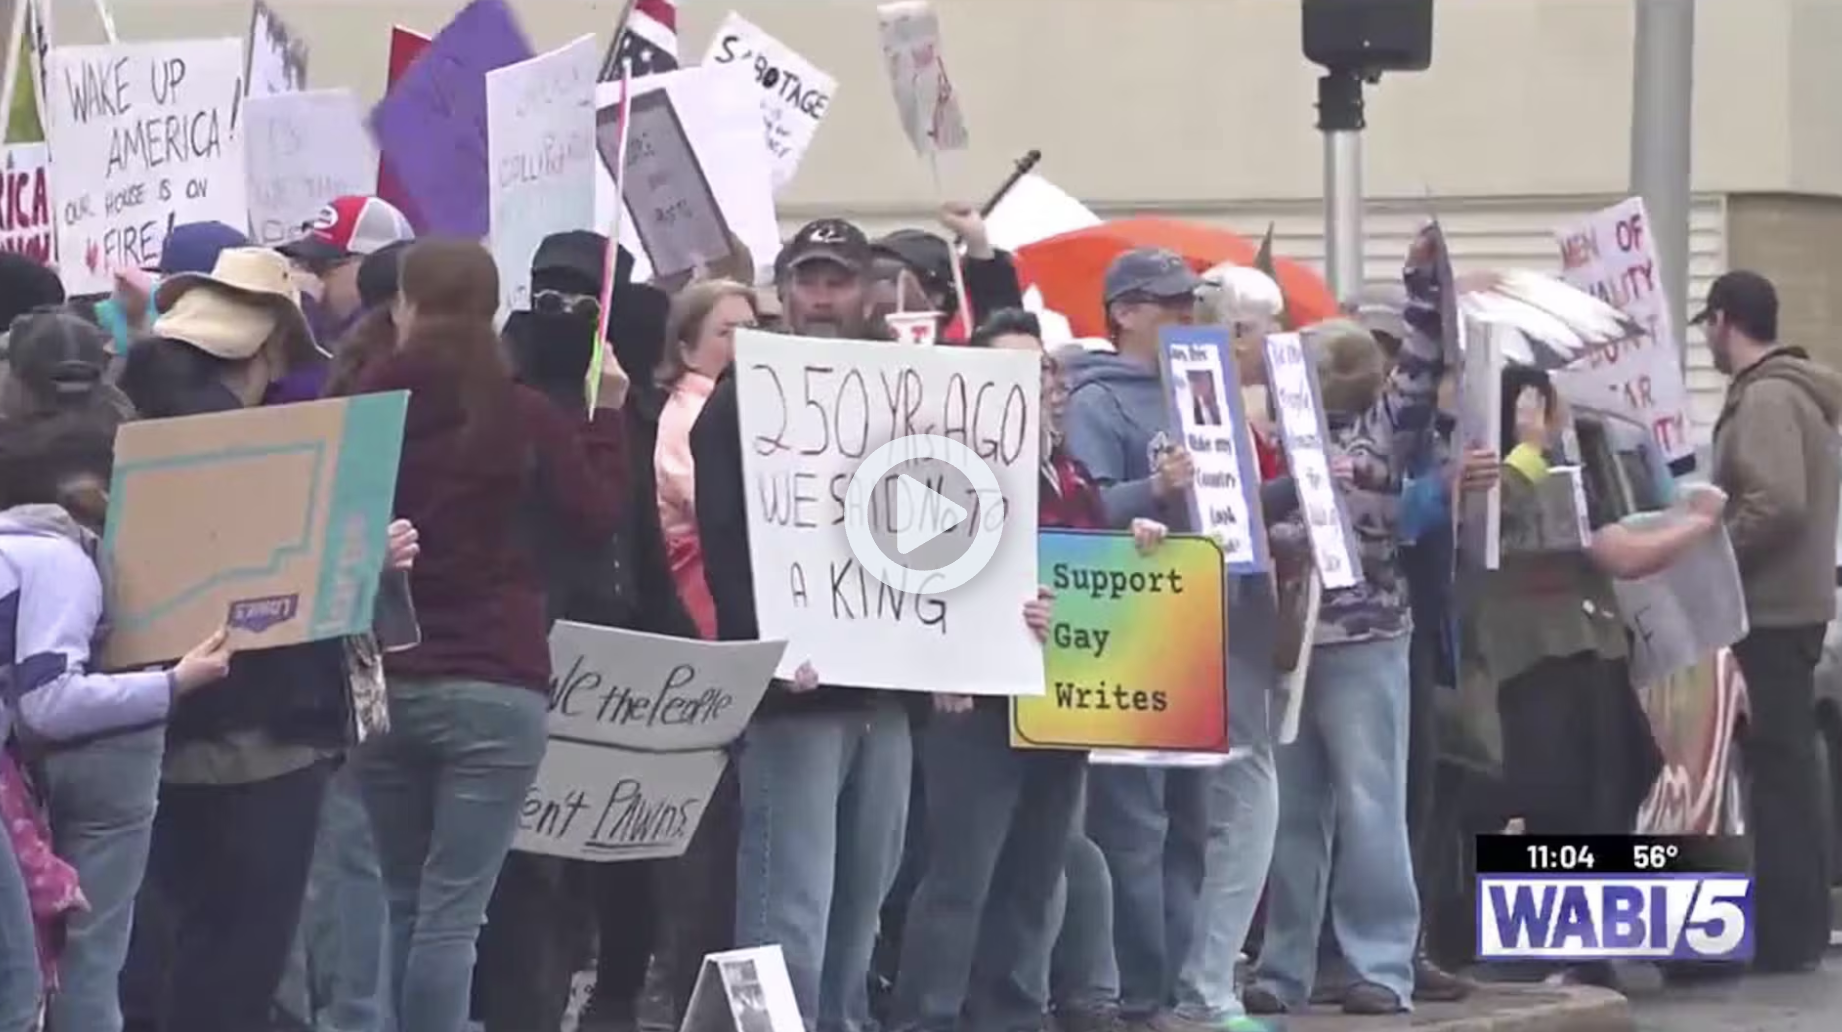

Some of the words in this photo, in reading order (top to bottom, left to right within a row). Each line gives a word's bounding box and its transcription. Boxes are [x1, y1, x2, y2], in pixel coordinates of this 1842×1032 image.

[65, 57, 130, 122] WAKE
[151, 58, 185, 105] UP
[0, 166, 49, 230] ICA
[64, 197, 95, 226] OUR
[104, 183, 145, 218] HOUSE
[158, 178, 171, 201] IS
[186, 178, 207, 199] ON
[1616, 213, 1643, 252] OF
[752, 364, 869, 458] 250
[944, 373, 1027, 466] AGO
[760, 472, 817, 528] WE
[830, 474, 914, 533] SAID
[791, 561, 807, 607] A
[831, 558, 946, 634] KING
[1053, 563, 1184, 599] Support
[1054, 623, 1110, 657] Gay
[597, 685, 650, 725] the
[1055, 681, 1168, 712] Writes
